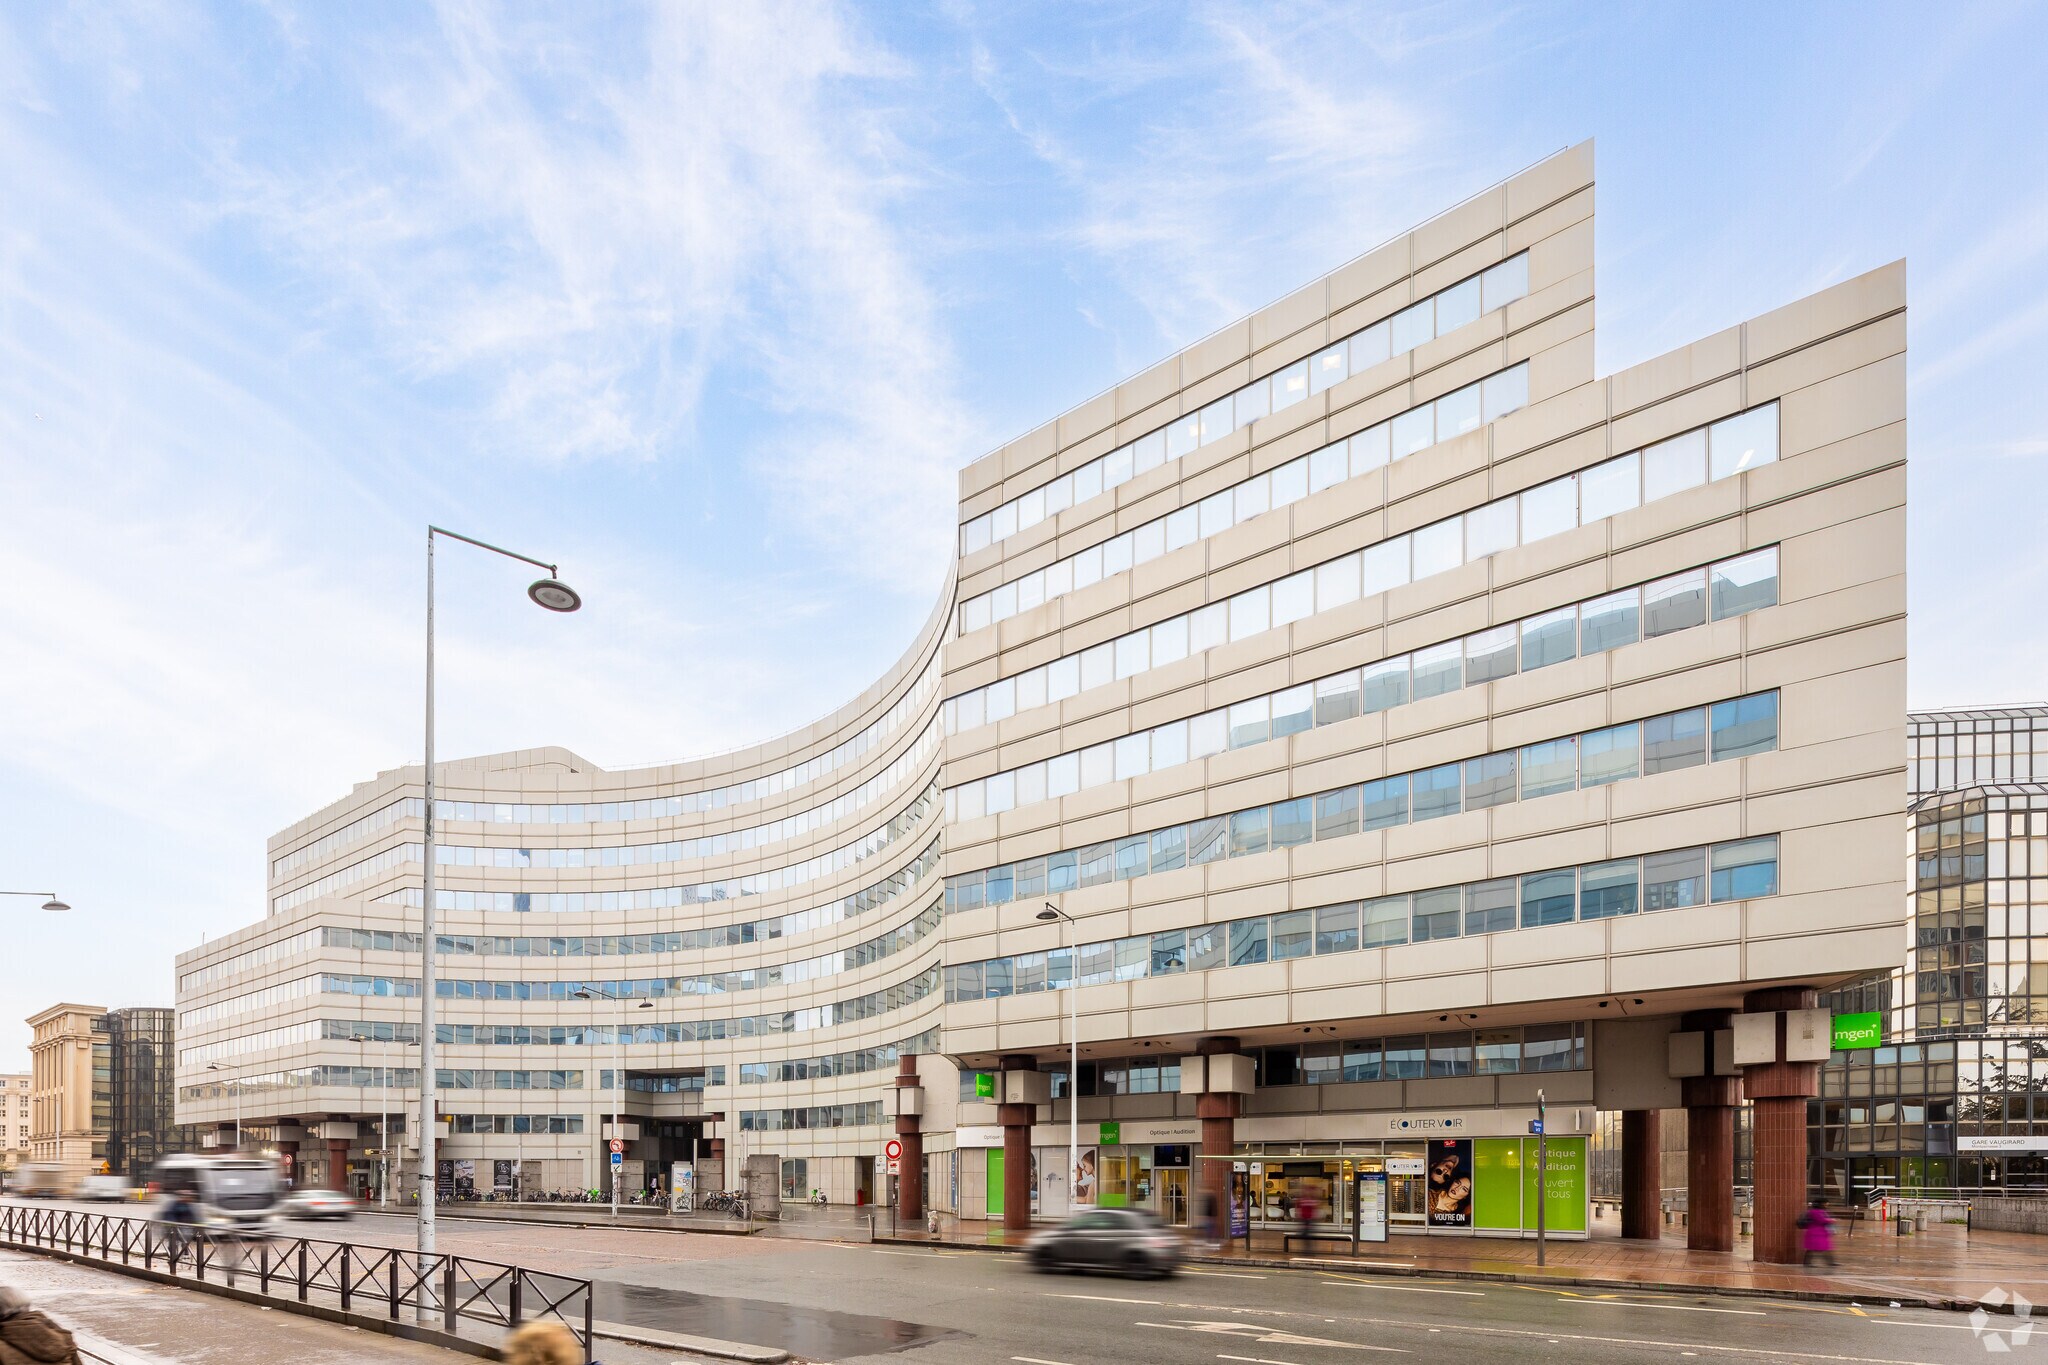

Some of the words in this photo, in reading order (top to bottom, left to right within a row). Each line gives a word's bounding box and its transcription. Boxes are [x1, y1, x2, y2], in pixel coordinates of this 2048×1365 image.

[1835, 1029, 1874, 1042] mgen
[1437, 1118, 1463, 1128] VOIR
[1100, 1132, 1116, 1140] mgen
[1532, 1149, 1576, 1159] Otique
[1532, 1162, 1576, 1171] Adition
[1547, 1189, 1571, 1199] tous
[1434, 1213, 1456, 1221] YOU'RE
[1456, 1213, 1465, 1222] ON
